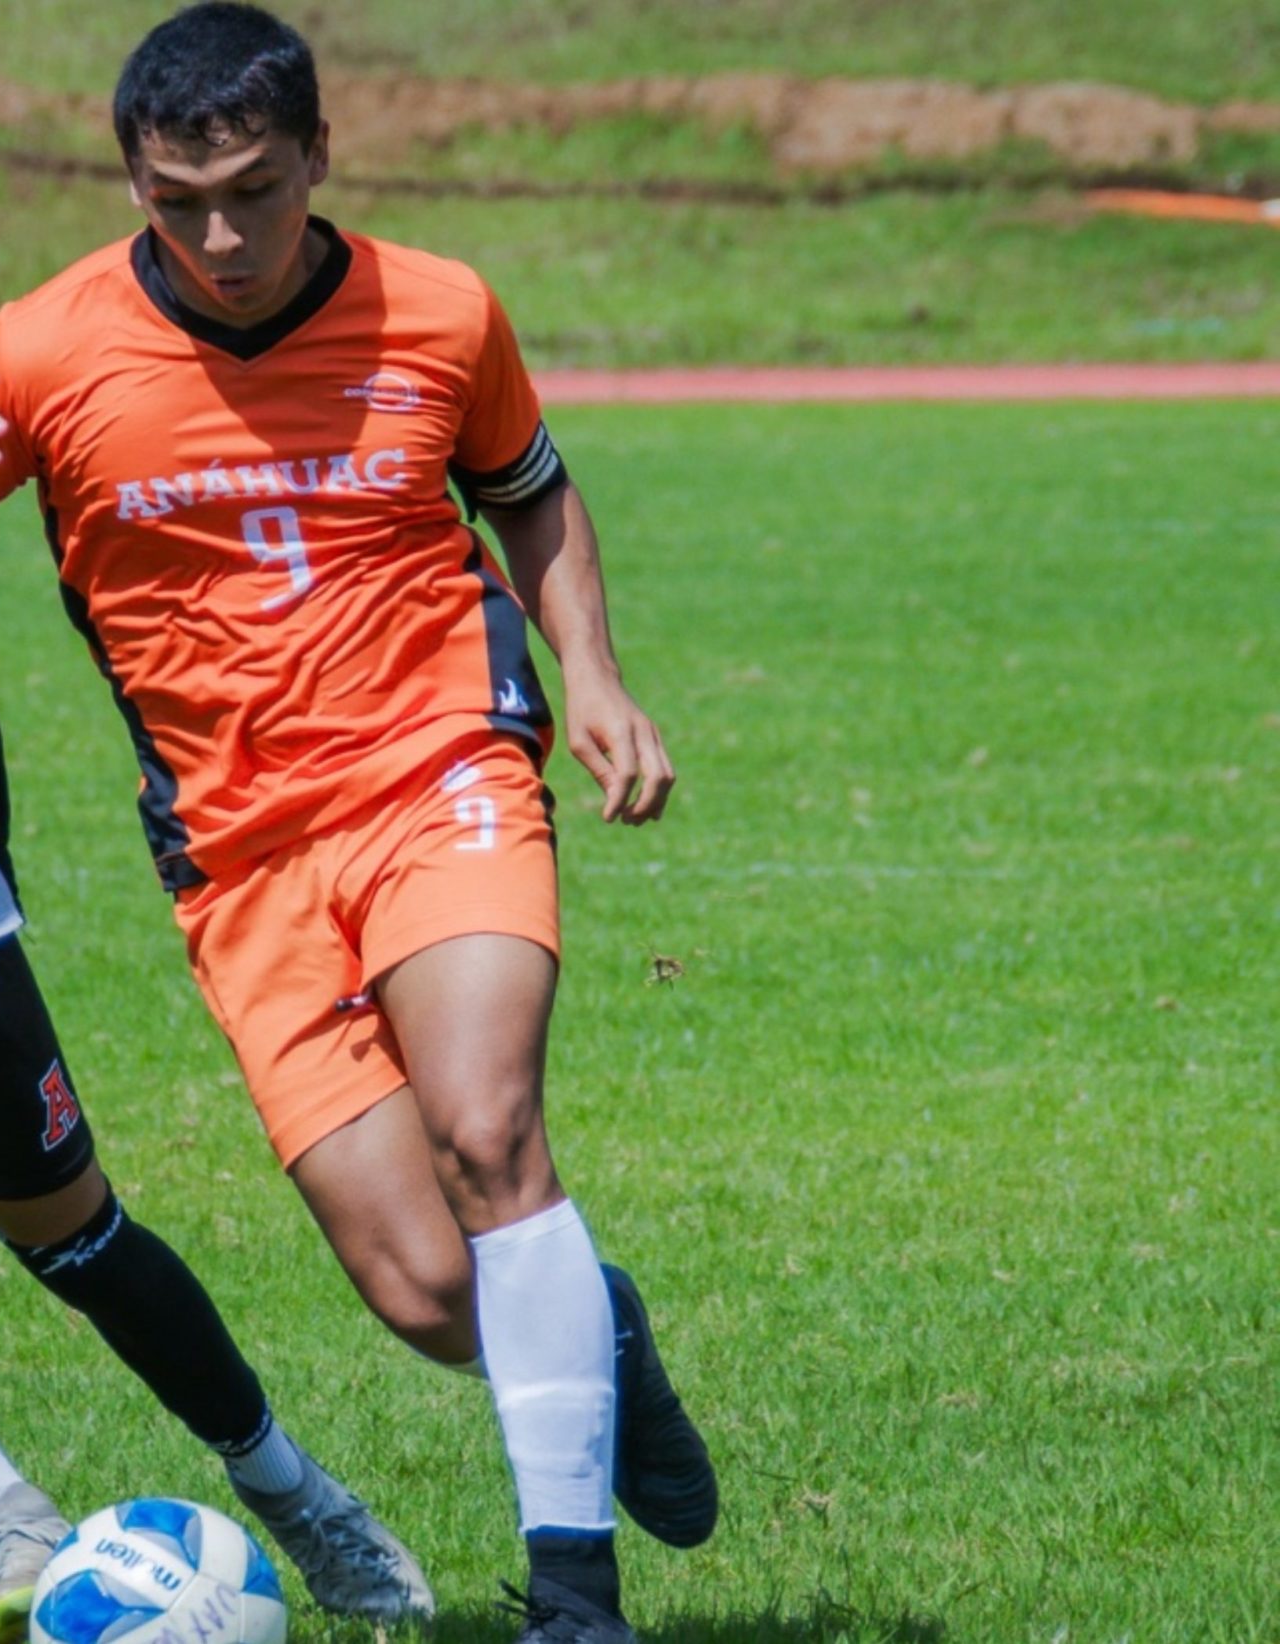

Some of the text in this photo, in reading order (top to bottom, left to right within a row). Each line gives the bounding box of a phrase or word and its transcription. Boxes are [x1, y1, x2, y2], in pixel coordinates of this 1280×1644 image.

[116, 446, 408, 520] ANÁHUAC
[240, 505, 313, 612] 9
[39, 1058, 80, 1152] A
